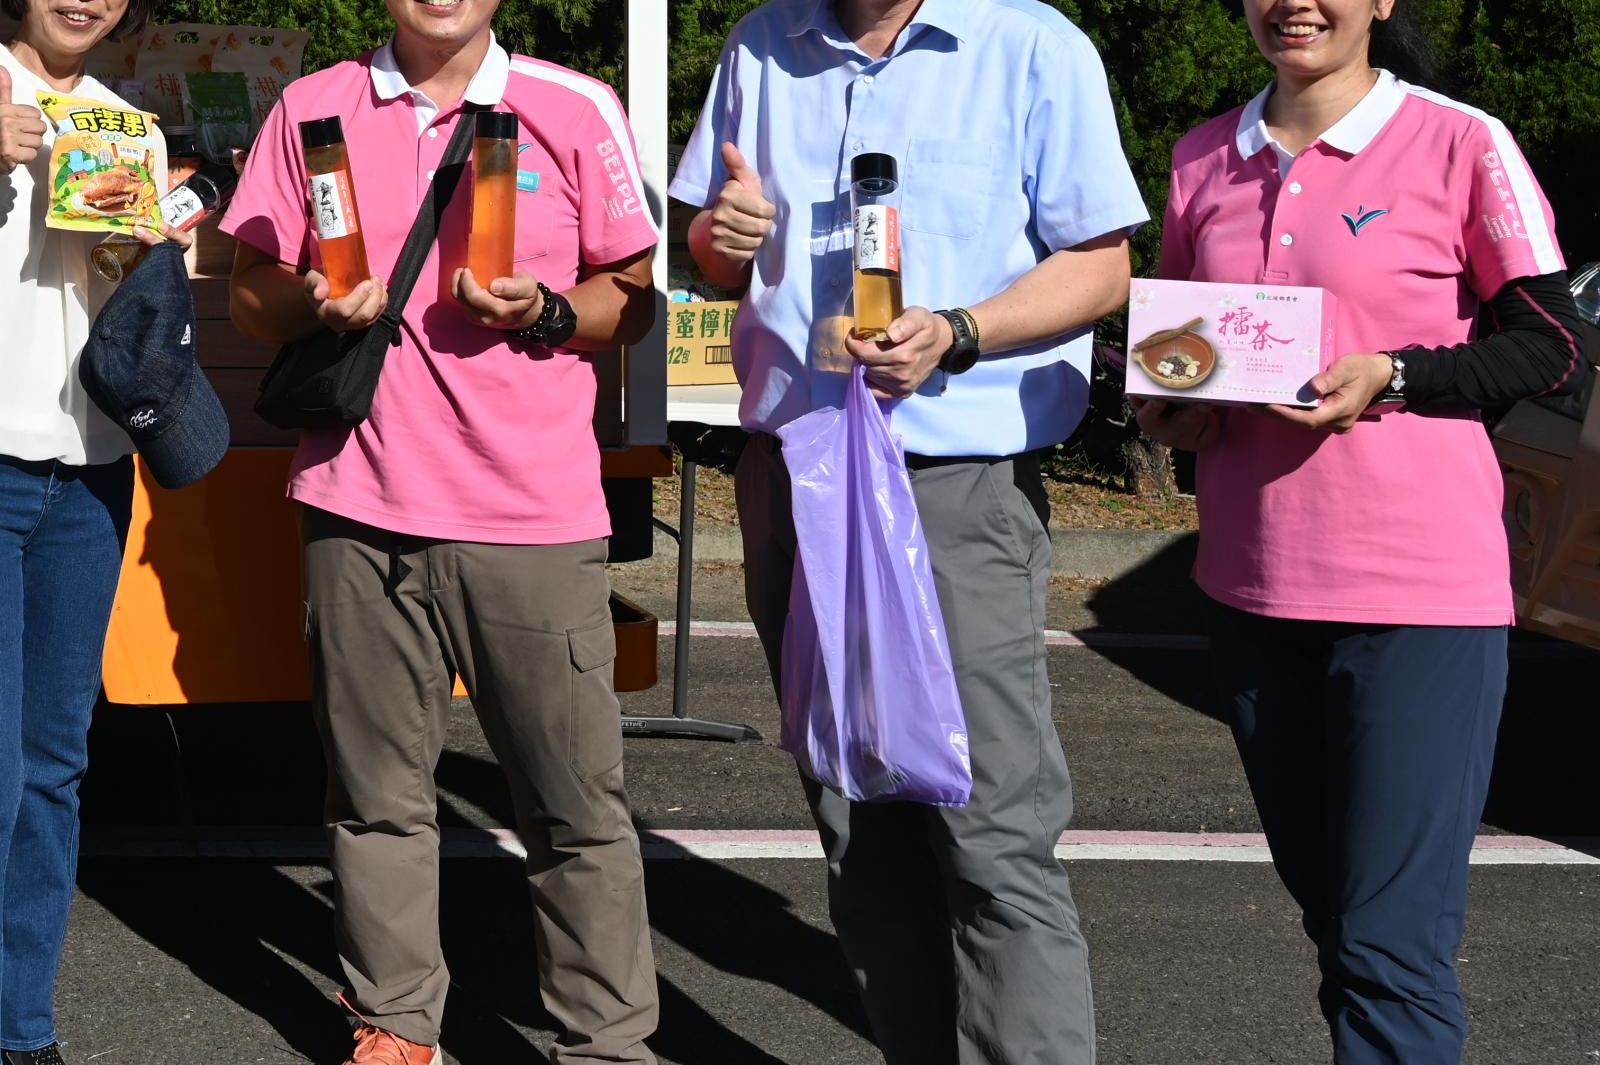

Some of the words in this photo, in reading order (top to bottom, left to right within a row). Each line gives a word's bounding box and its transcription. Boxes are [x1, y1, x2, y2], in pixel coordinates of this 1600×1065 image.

[596, 138, 642, 215] BEIPU
[667, 307, 736, 338] 蜜檸
[1218, 306, 1296, 351] 擂茶
